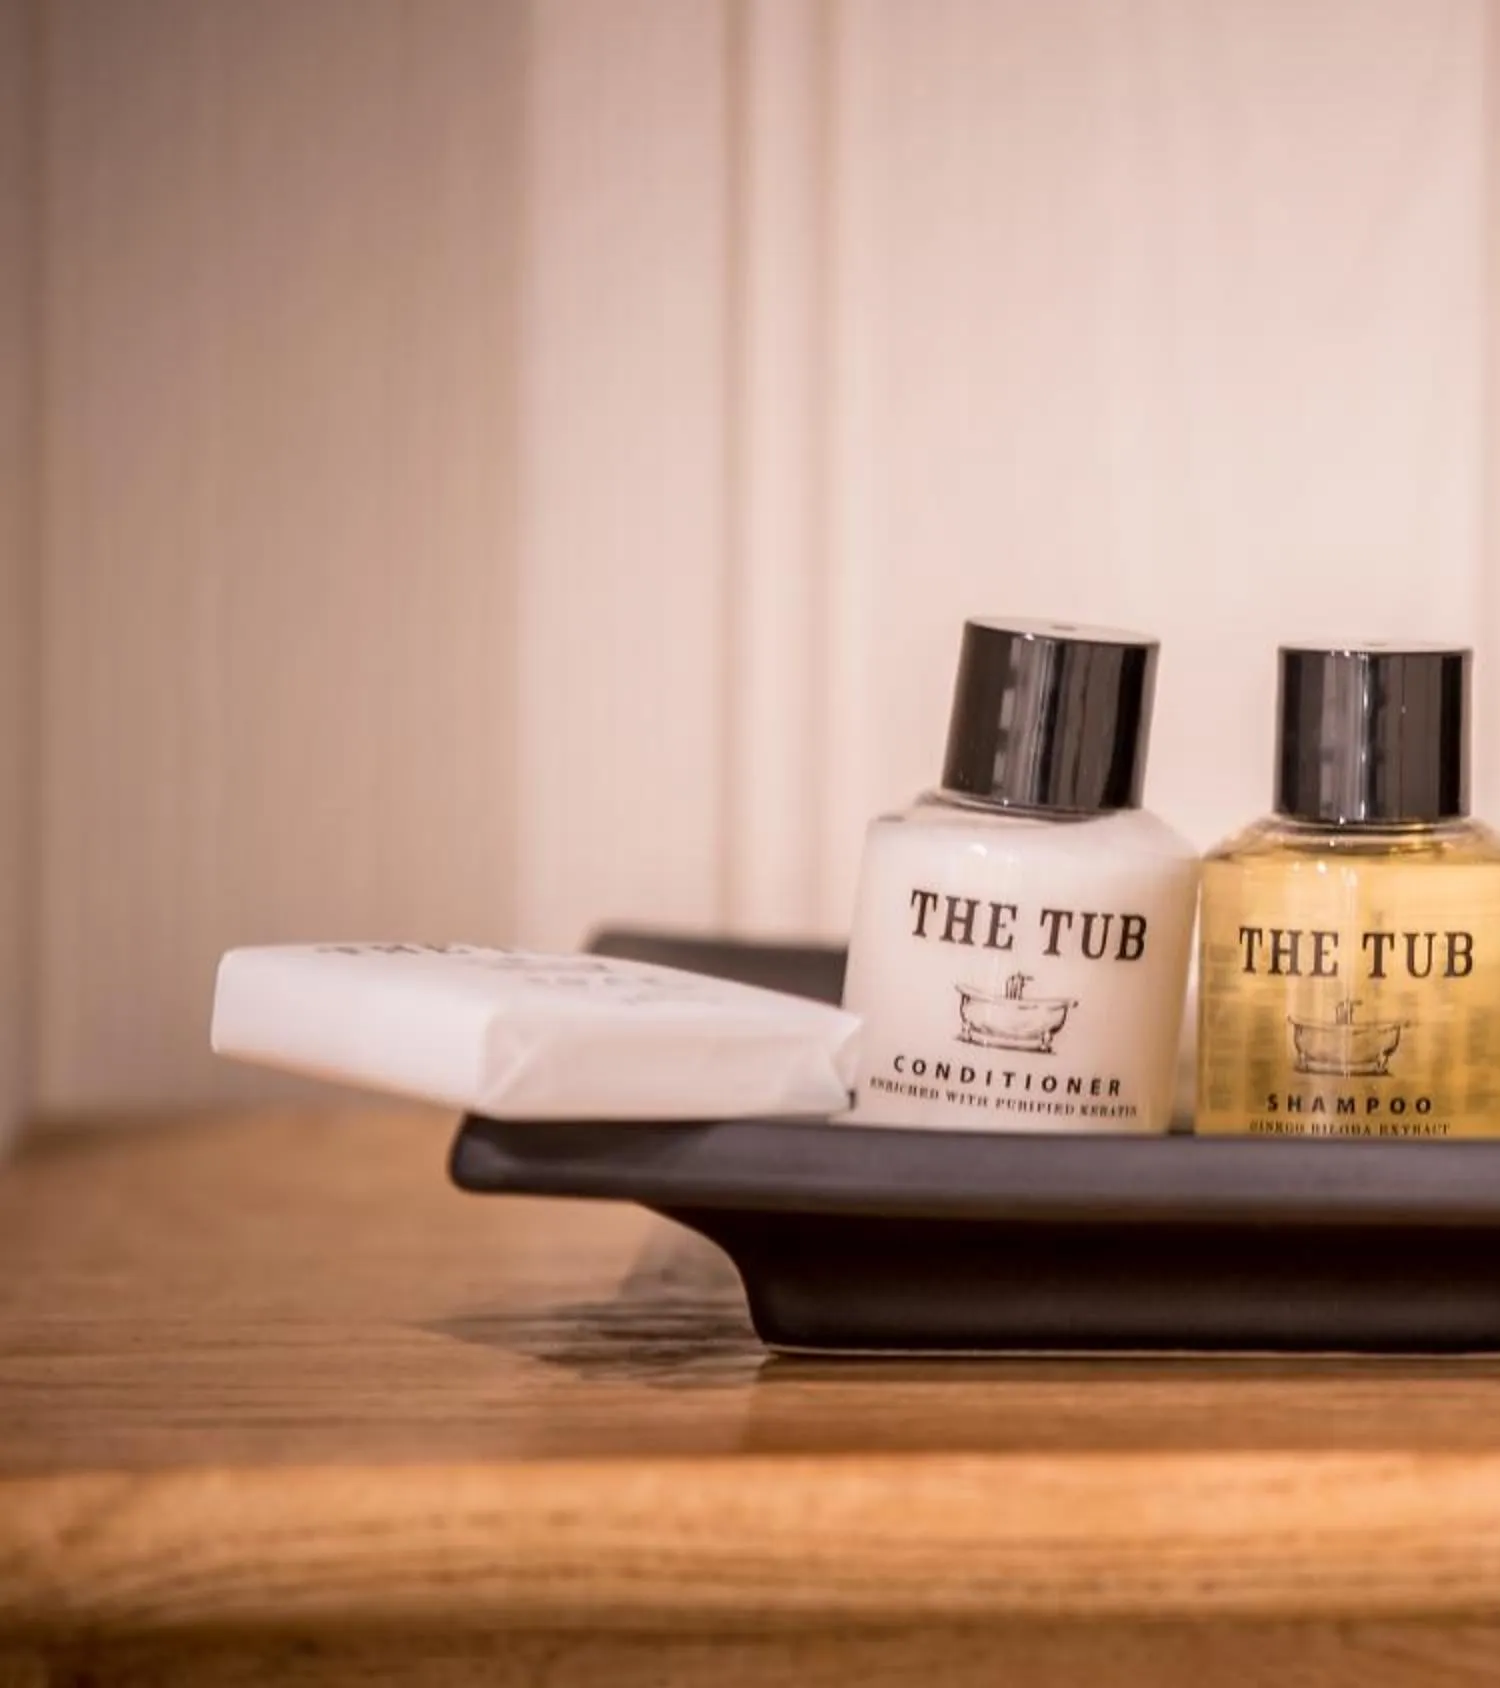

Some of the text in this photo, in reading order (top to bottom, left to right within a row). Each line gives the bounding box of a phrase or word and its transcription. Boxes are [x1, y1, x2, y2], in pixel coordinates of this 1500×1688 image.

[910, 889, 1147, 961] THE TUB
[1239, 926, 1474, 978] THE TUB
[869, 1076, 939, 1100] ENRICHED
[946, 1091, 988, 1107] WITH
[893, 1055, 1122, 1097] CONDITIONER
[1267, 1093, 1432, 1115] SHAMPOO
[1379, 1122, 1450, 1137] EXTRACT
